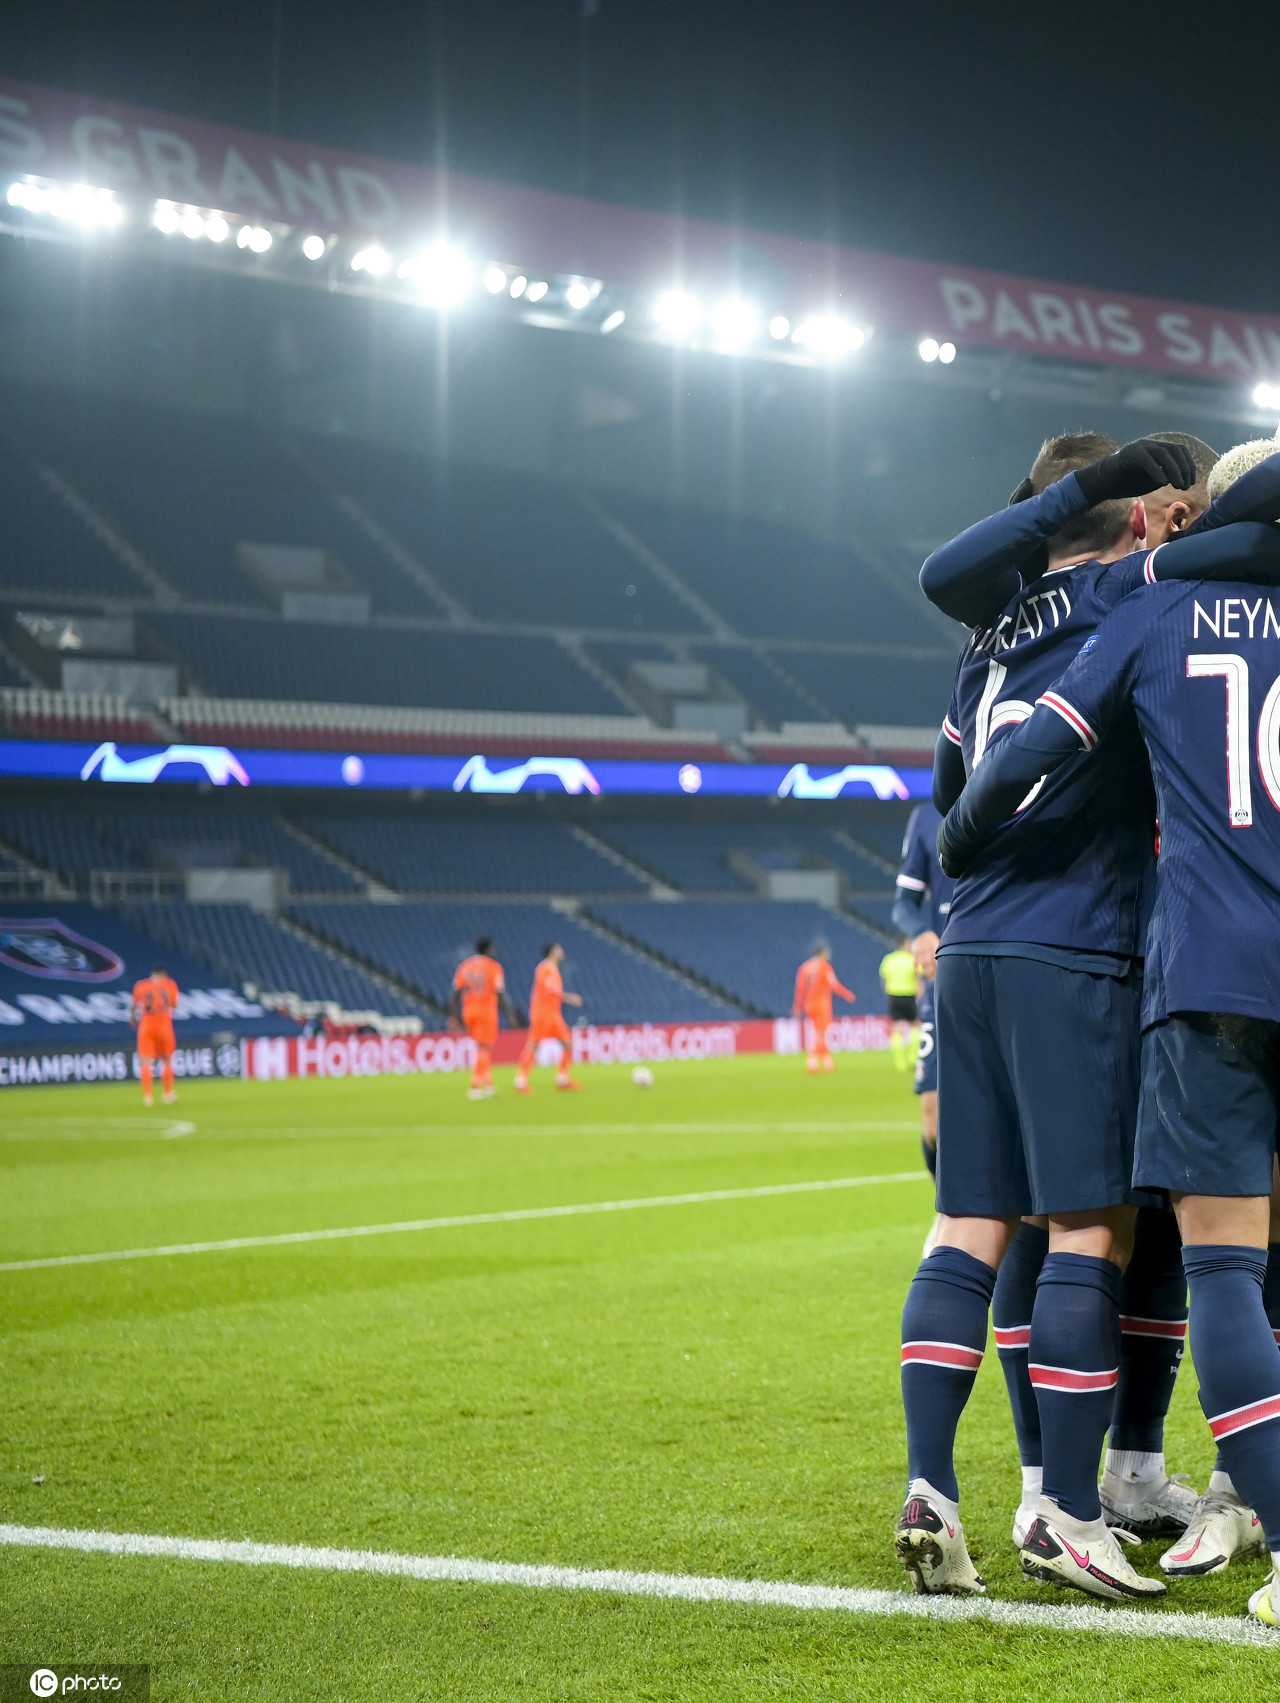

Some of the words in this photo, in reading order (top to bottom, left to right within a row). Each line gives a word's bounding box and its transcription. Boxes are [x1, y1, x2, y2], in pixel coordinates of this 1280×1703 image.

[72, 115, 401, 238] GRAND
[938, 277, 1145, 356] PARIS
[571, 1023, 737, 1065] Hotels.com
[918, 1022, 934, 1058] 5
[0, 1051, 127, 1085] CHAMPIONS
